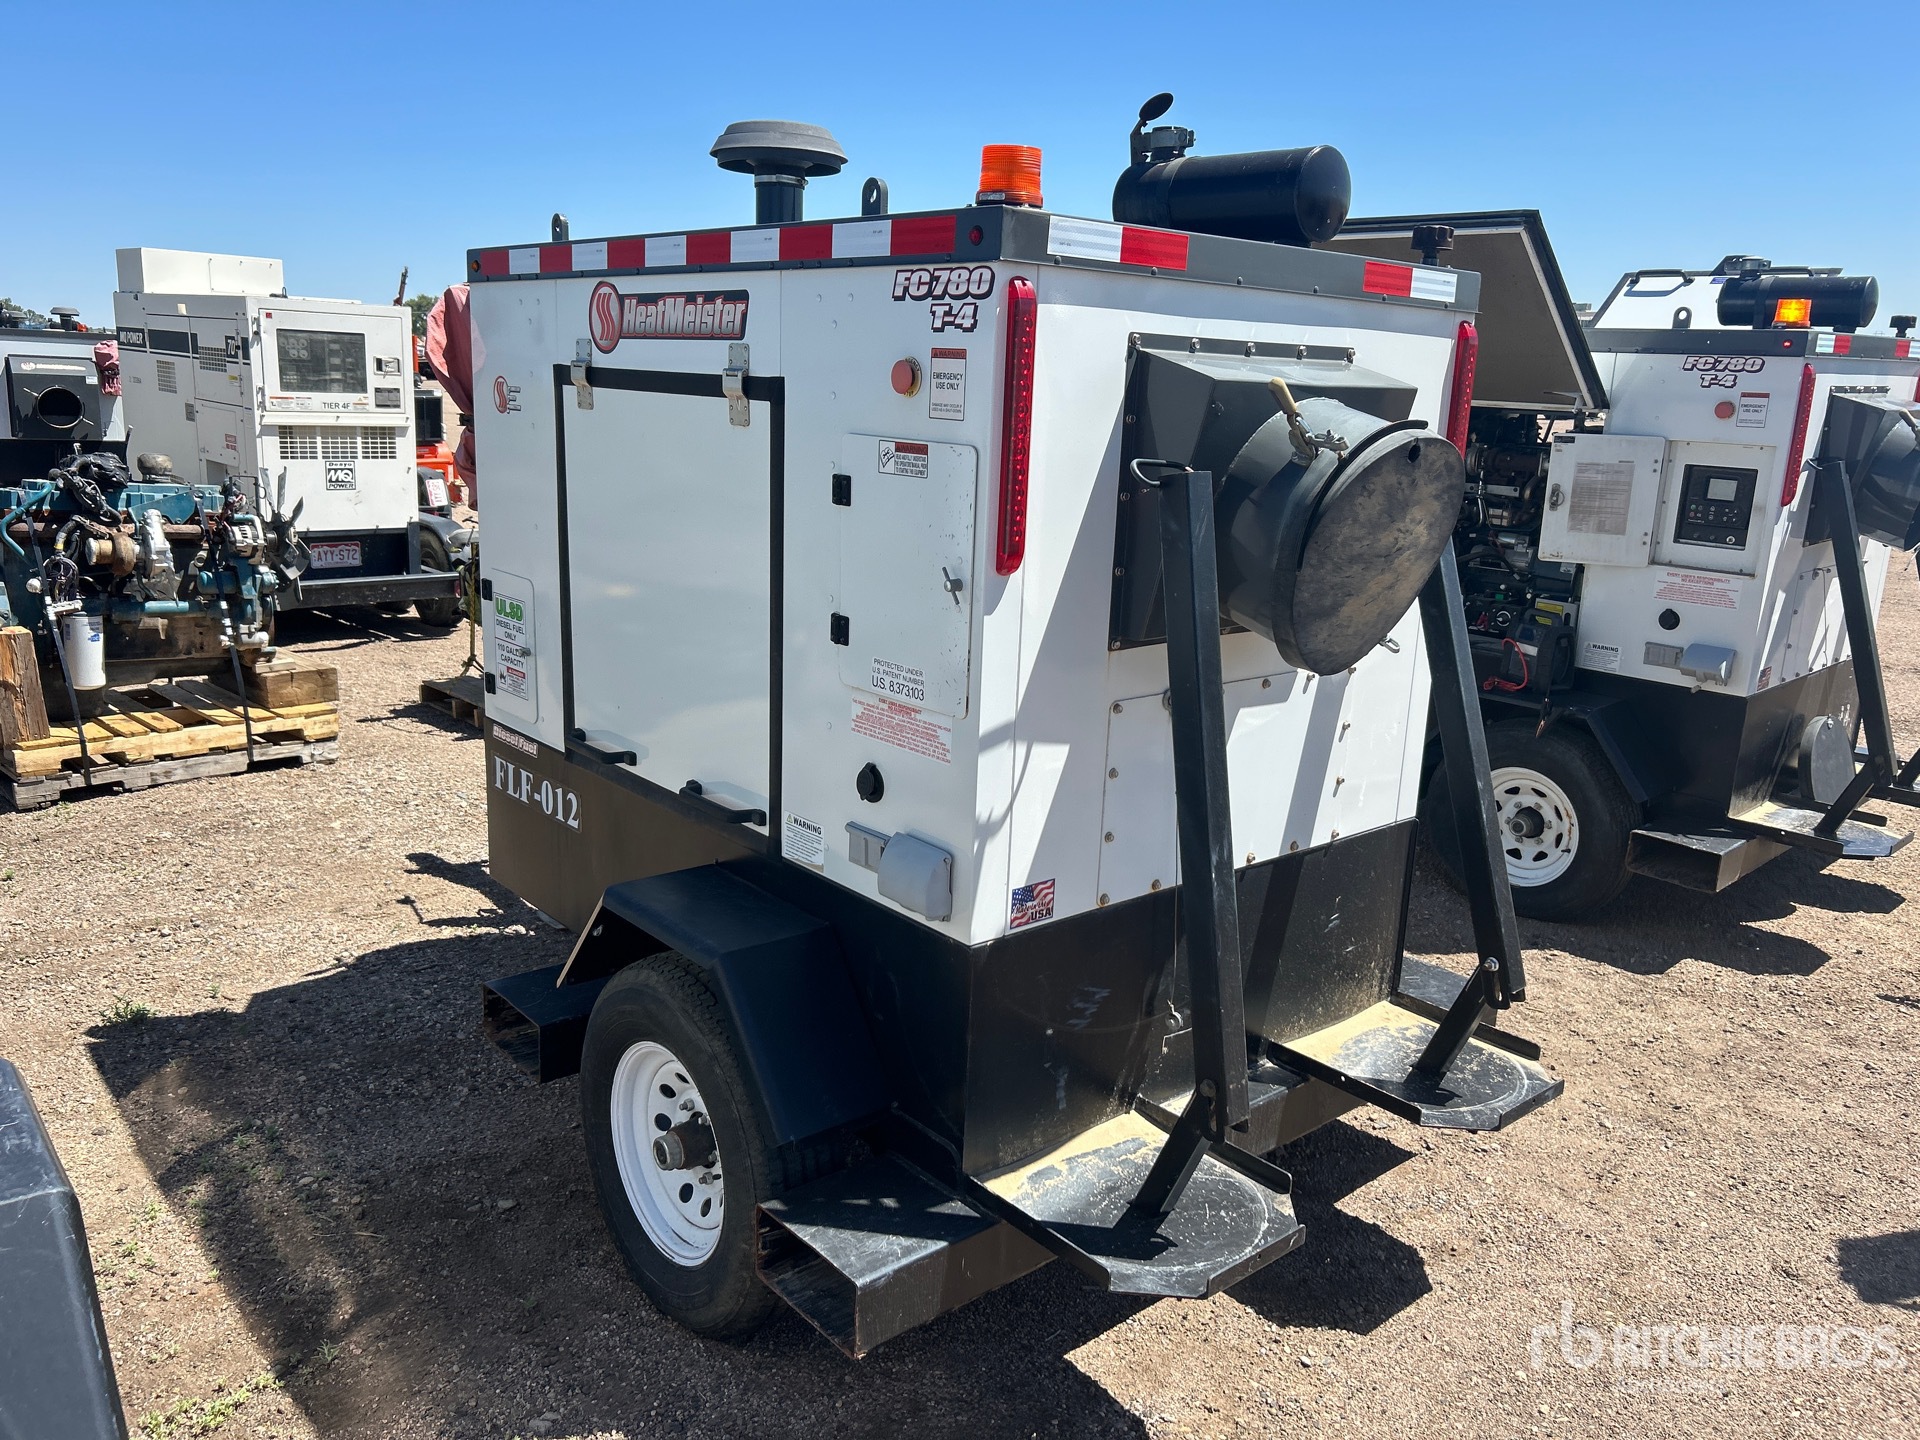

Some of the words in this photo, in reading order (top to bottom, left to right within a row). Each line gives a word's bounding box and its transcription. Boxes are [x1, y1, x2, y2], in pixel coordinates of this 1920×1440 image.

[892, 266, 995, 301] FC780
[622, 294, 747, 337] HeatMeister
[930, 303, 978, 332] T-4
[227, 339, 236, 355] 70
[938, 350, 965, 358] WARNING
[1682, 355, 1765, 373] FC780
[932, 371, 963, 381] EMERGENCY
[1700, 374, 1738, 388] T-4
[935, 380, 946, 389] USE
[947, 382, 960, 391] ONLY
[322, 401, 339, 409] TIER
[327, 469, 354, 483] MQ
[495, 597, 523, 622] ULSD
[496, 618, 513, 632] DIESEL
[513, 624, 525, 635] FUEL
[505, 630, 517, 642] ONLY
[1592, 643, 1619, 652] WARNING
[501, 653, 524, 669] CAPACITY
[873, 658, 904, 673] PROTECTED
[905, 665, 924, 677] UNDER
[872, 667, 881, 675] U.S.
[882, 670, 901, 681] PATENT
[902, 675, 925, 687] NUMBER
[872, 675, 887, 690] U.S.
[888, 680, 925, 702] 8,373,103
[493, 725, 519, 749] Diesel
[519, 736, 538, 757] Fuel
[494, 755, 580, 829] FLF-012
[793, 816, 822, 836] WARNING
[1030, 906, 1052, 921] USA
